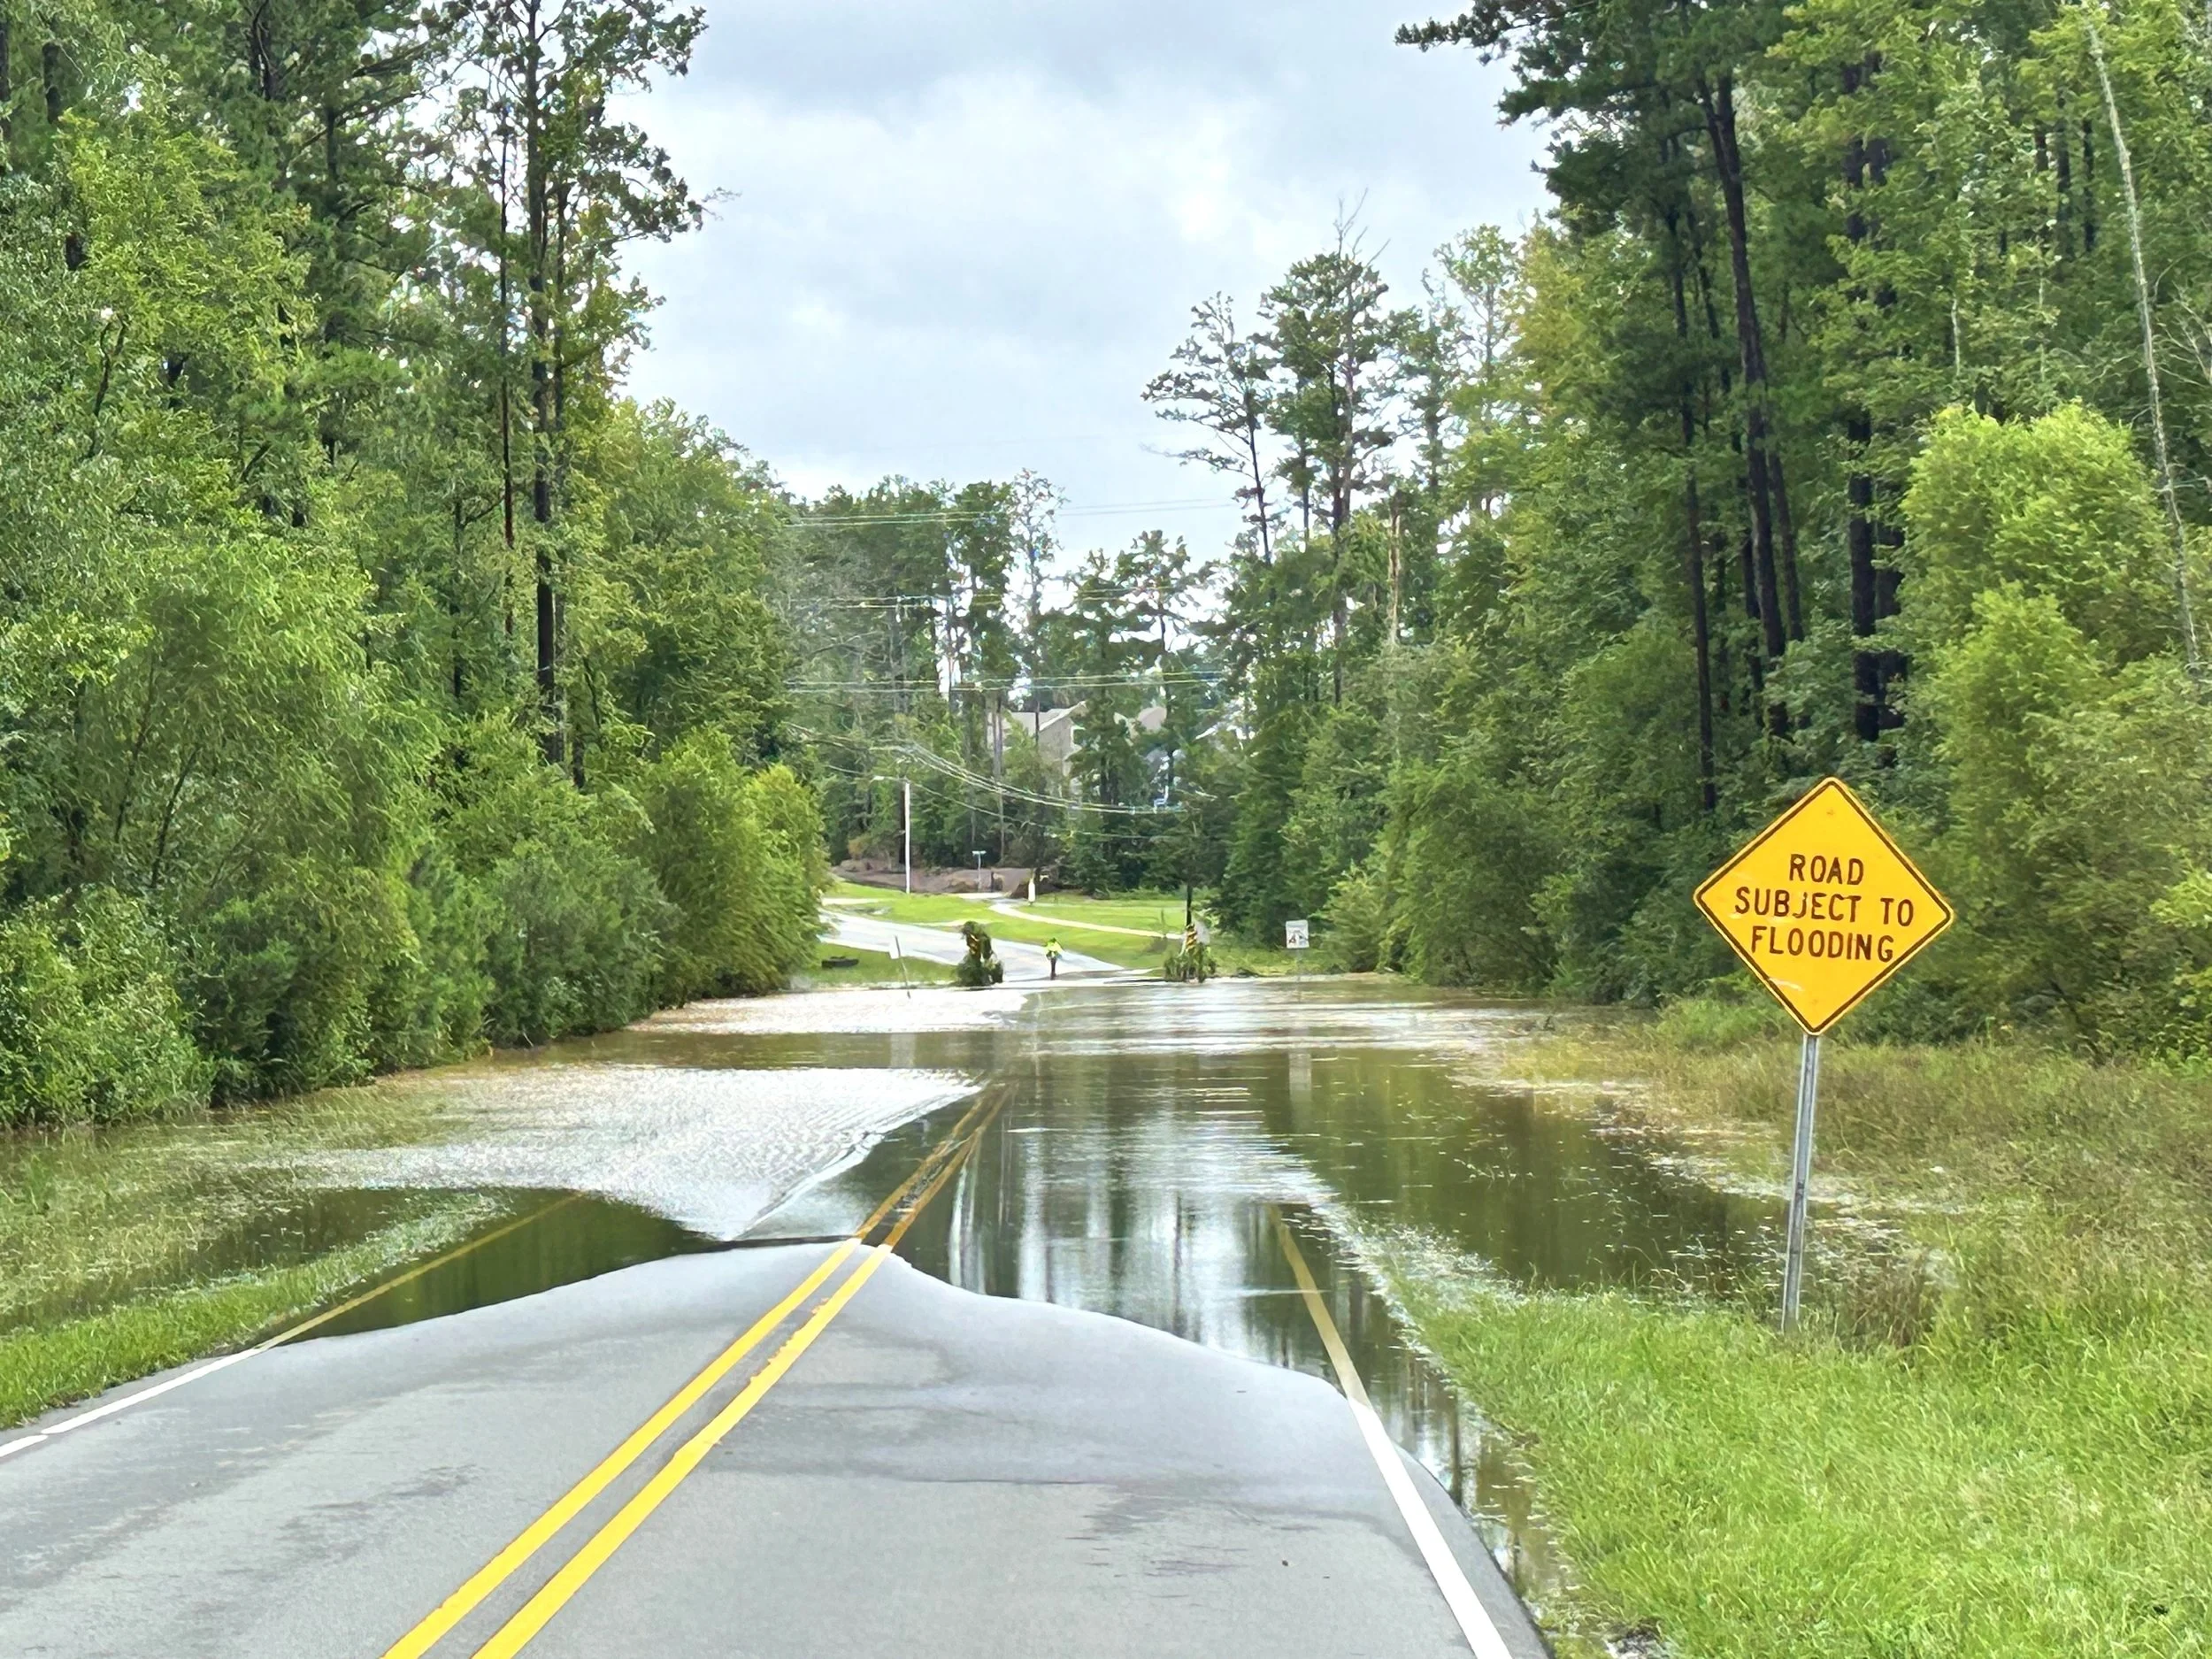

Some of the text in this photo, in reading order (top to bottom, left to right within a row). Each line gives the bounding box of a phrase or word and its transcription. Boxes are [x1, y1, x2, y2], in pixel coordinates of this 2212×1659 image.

[1789, 854, 1863, 885] ROAD
[1735, 887, 1914, 926] SUBJECT TO
[1752, 926, 1893, 963] FLOODING
